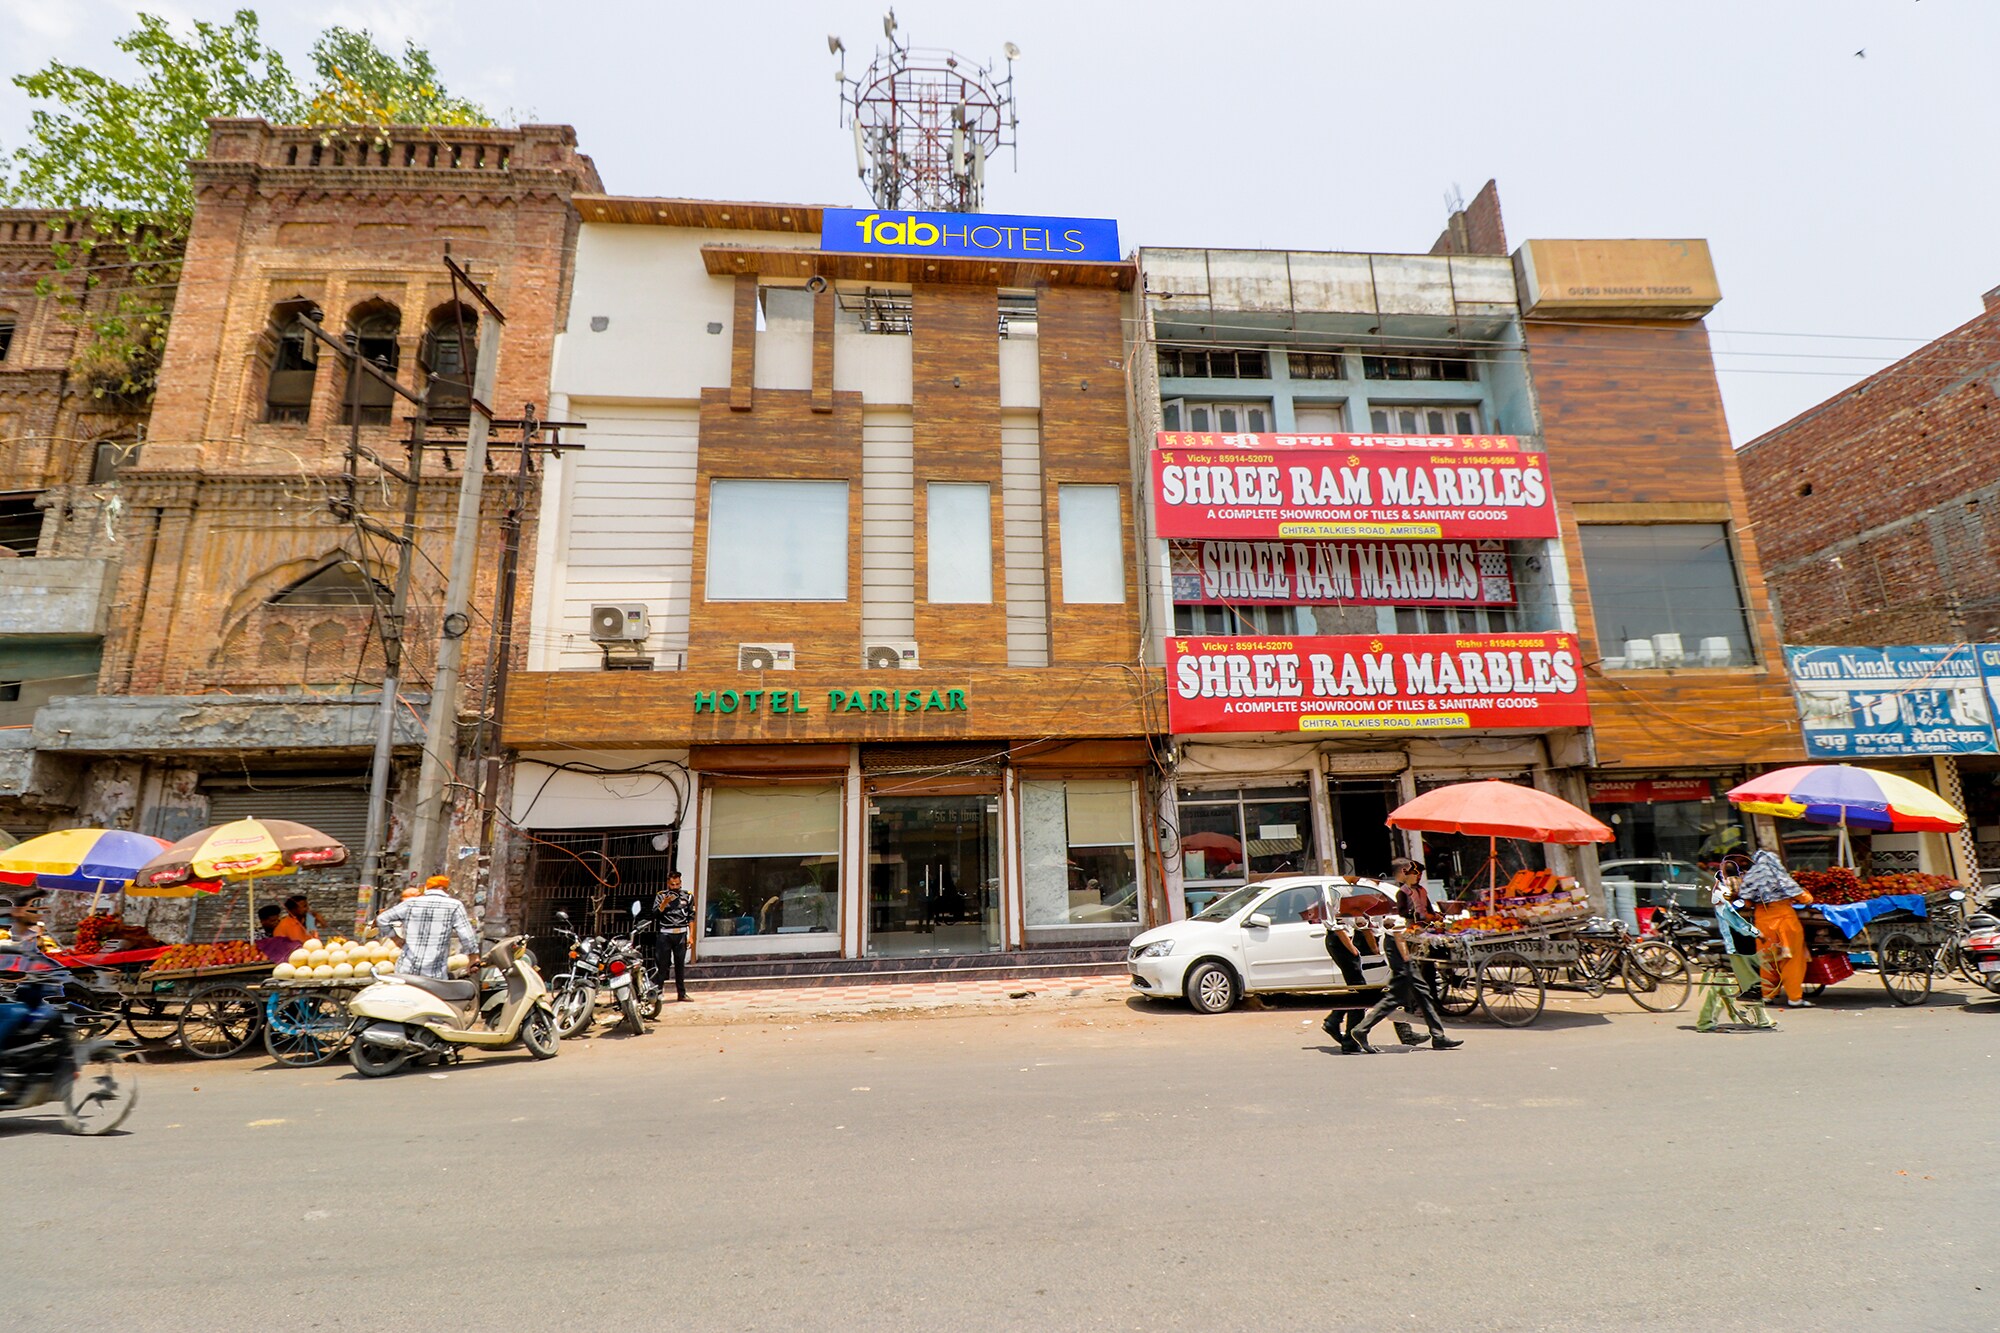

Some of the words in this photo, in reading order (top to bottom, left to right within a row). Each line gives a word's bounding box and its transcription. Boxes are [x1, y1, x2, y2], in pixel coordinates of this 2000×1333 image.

[1568, 287, 1600, 296] GURU
[1602, 287, 1644, 295] NANAK
[1646, 286, 1692, 295] TRADERS
[1187, 454, 1211, 464] Vicky
[1219, 454, 1274, 463] 85914-52070
[1430, 456, 1456, 464] Rishu
[1162, 465, 1283, 506] SHREE
[1289, 466, 1373, 506] RAM
[1378, 466, 1546, 507] MARBLES
[1207, 509, 1216, 519] A
[1218, 509, 1278, 520] COMPLETE
[1280, 509, 1351, 520] SHOWROOM
[1353, 510, 1369, 520] OF
[1371, 510, 1399, 520] TILES
[1401, 510, 1411, 520] &
[1413, 510, 1466, 520] SANITARY
[1468, 510, 1508, 520] GOODS
[1281, 526, 1317, 535] CHITRA
[1318, 526, 1357, 535] TALKIES
[1202, 541, 1291, 600] SHREE
[1293, 541, 1355, 600] RAM
[1356, 542, 1479, 600] MARBLES
[1202, 642, 1228, 652] Vicky
[1236, 642, 1293, 650] 85914-52070
[1456, 640, 1482, 648] Rishu
[1793, 653, 1841, 679] Guru
[1840, 652, 1899, 679] Nanak
[1899, 660, 1976, 678] SANITATION
[1176, 654, 1303, 699] SHREE
[1309, 653, 1398, 696] RAM
[1402, 651, 1578, 696] MARBLES
[694, 690, 808, 713] HOTEL
[828, 689, 967, 712] PARISAR
[1223, 702, 1233, 713] A
[1235, 702, 1298, 713] COMPLETE
[1300, 701, 1375, 712] SHOWROOM
[1377, 701, 1393, 711] OF
[1395, 700, 1425, 711] TILES
[1427, 700, 1437, 710] &
[1439, 698, 1494, 710] SANITARY
[1496, 697, 1538, 709] GOODS
[1302, 719, 1338, 728] CHITRA
[1341, 718, 1381, 728] TALKIES
[1854, 731, 1904, 746] ਨਾਨਕ
